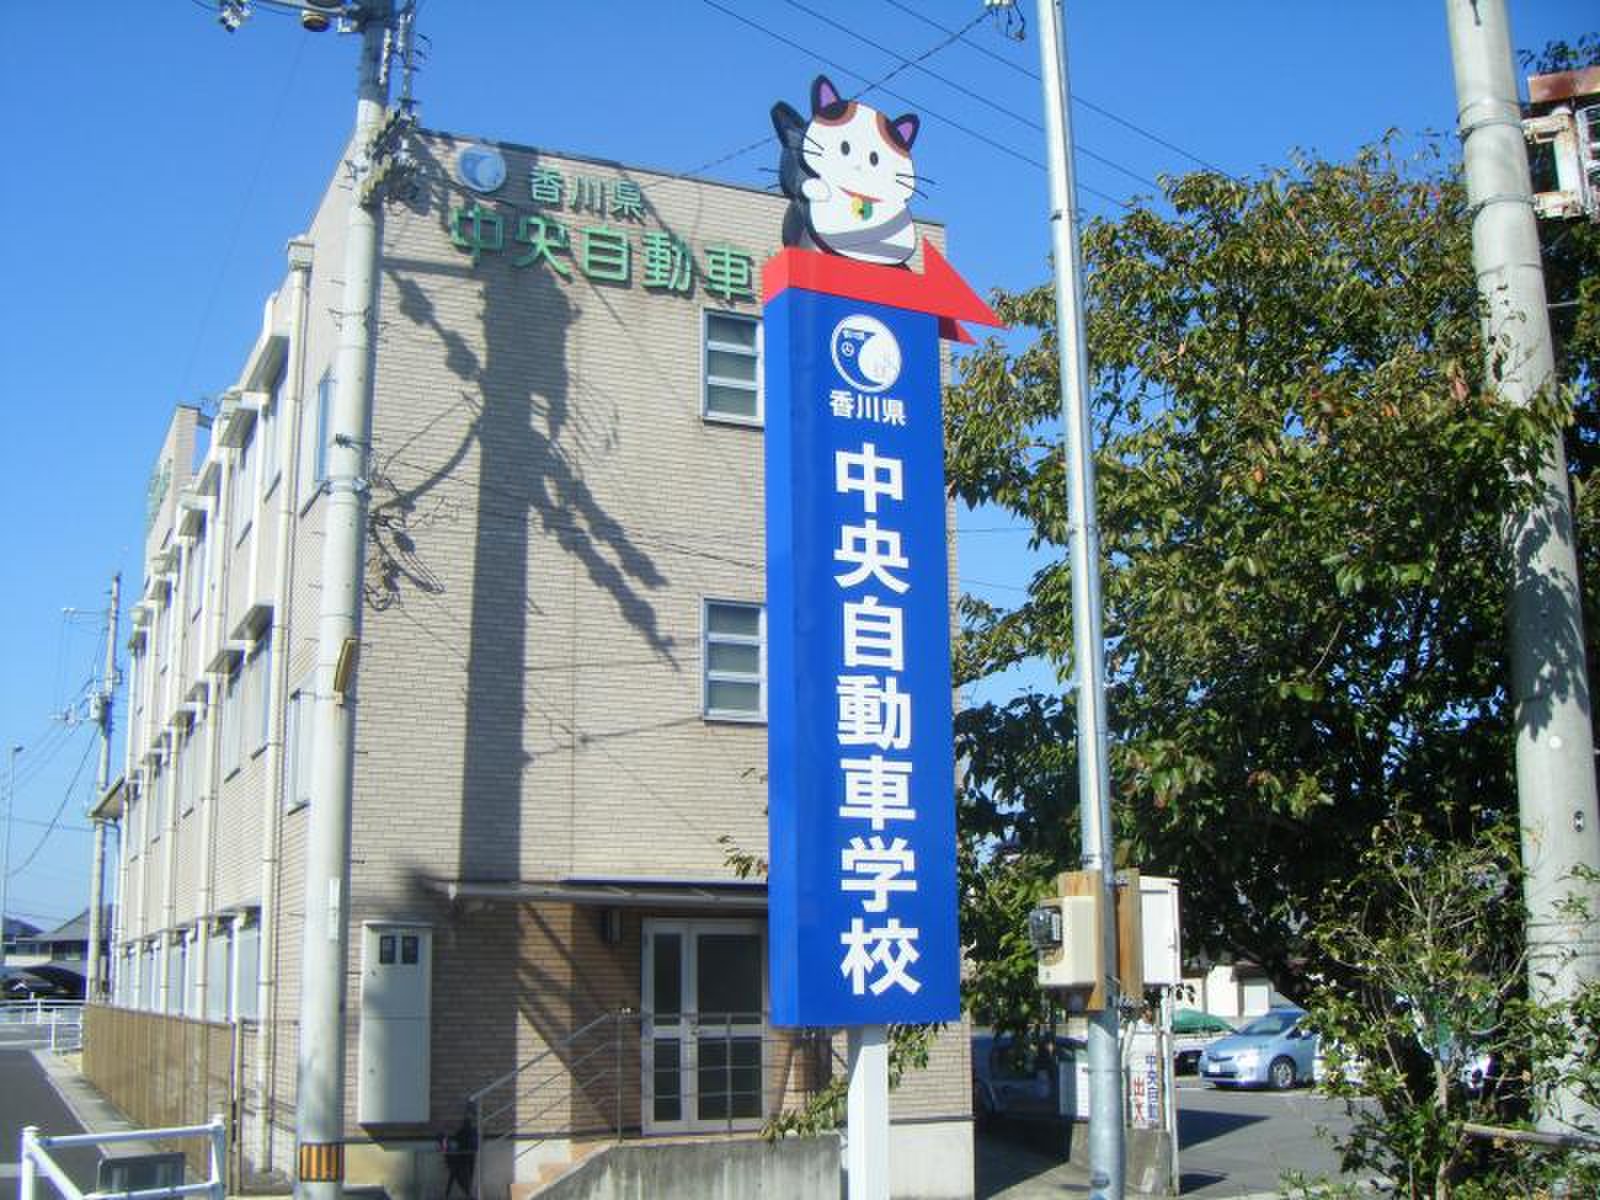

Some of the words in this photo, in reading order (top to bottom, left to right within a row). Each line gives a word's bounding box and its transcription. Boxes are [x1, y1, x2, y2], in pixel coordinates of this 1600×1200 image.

[531, 165, 643, 218] 香川県
[451, 204, 753, 299] 中央自動車
[829, 389, 906, 427] 香川県
[833, 441, 922, 997] 中央自動車学校
